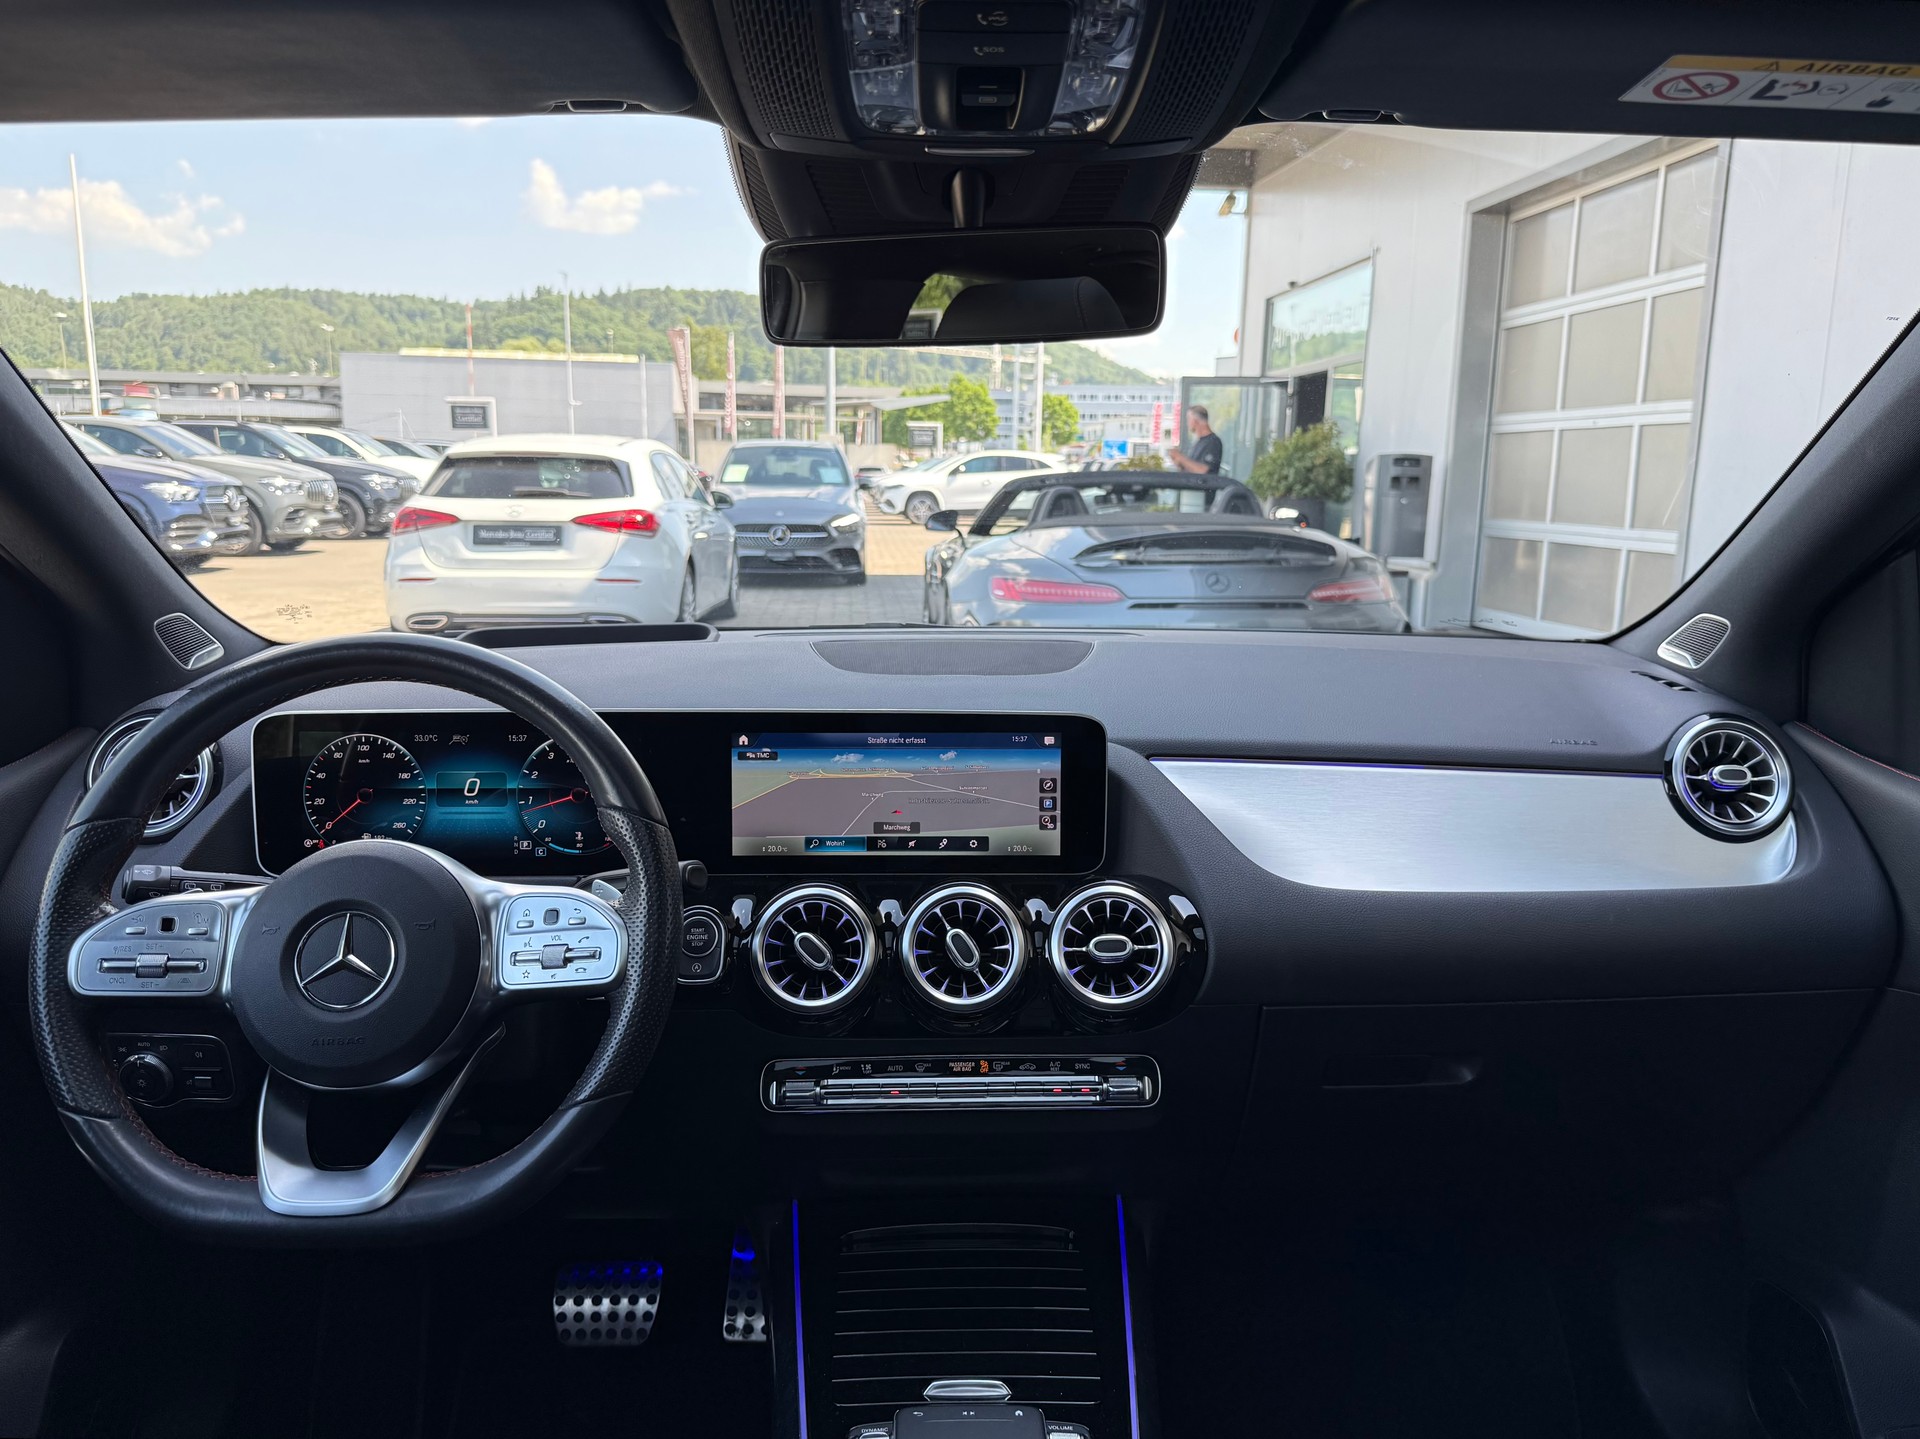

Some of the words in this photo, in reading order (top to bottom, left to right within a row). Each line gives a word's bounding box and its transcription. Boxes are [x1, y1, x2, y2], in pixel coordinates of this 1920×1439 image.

[1793, 62, 1913, 76] AIRBAG
[414, 734, 438, 742] 33.0°C
[508, 734, 528, 742] 15:37
[867, 736, 888, 744] Straße
[889, 736, 904, 744] nicht
[905, 736, 927, 744] erfasst
[357, 744, 370, 752] 100
[547, 752, 555, 760] 3
[530, 771, 539, 779] 2
[463, 777, 481, 797] 0
[313, 797, 325, 805] 20
[528, 796, 534, 805] 1
[325, 820, 333, 830] 0
[537, 819, 546, 829] 0
[883, 824, 911, 832] Marchweg
[550, 934, 563, 942] VOL
[686, 933, 709, 941] ENGINE
[108, 977, 126, 985] CNCL
[1074, 1062, 1091, 1070] SYNC
